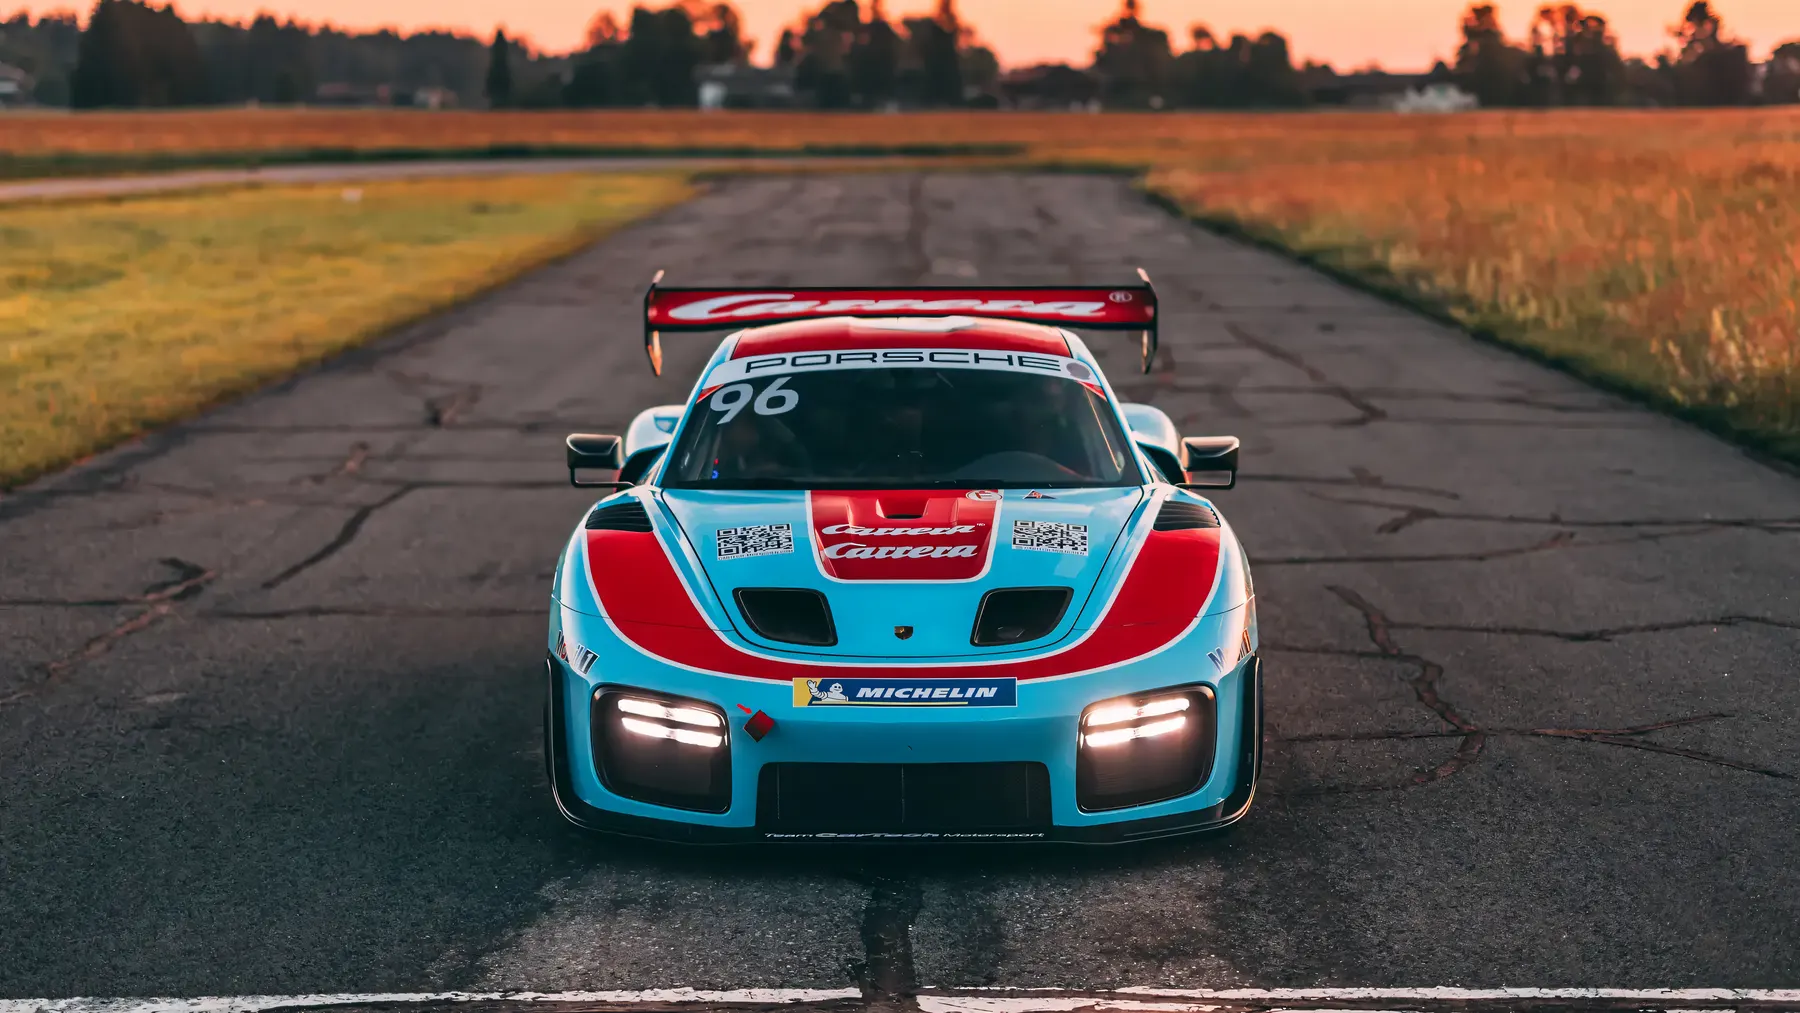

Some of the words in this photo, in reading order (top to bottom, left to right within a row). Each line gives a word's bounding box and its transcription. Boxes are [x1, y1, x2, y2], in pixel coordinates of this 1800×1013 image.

[668, 293, 1107, 320] Carrera
[745, 352, 1062, 374] PORSCHE
[710, 376, 800, 425] 96
[821, 523, 976, 537] Carrera
[825, 542, 978, 560] Carrera
[855, 687, 998, 699] MICHELIN
